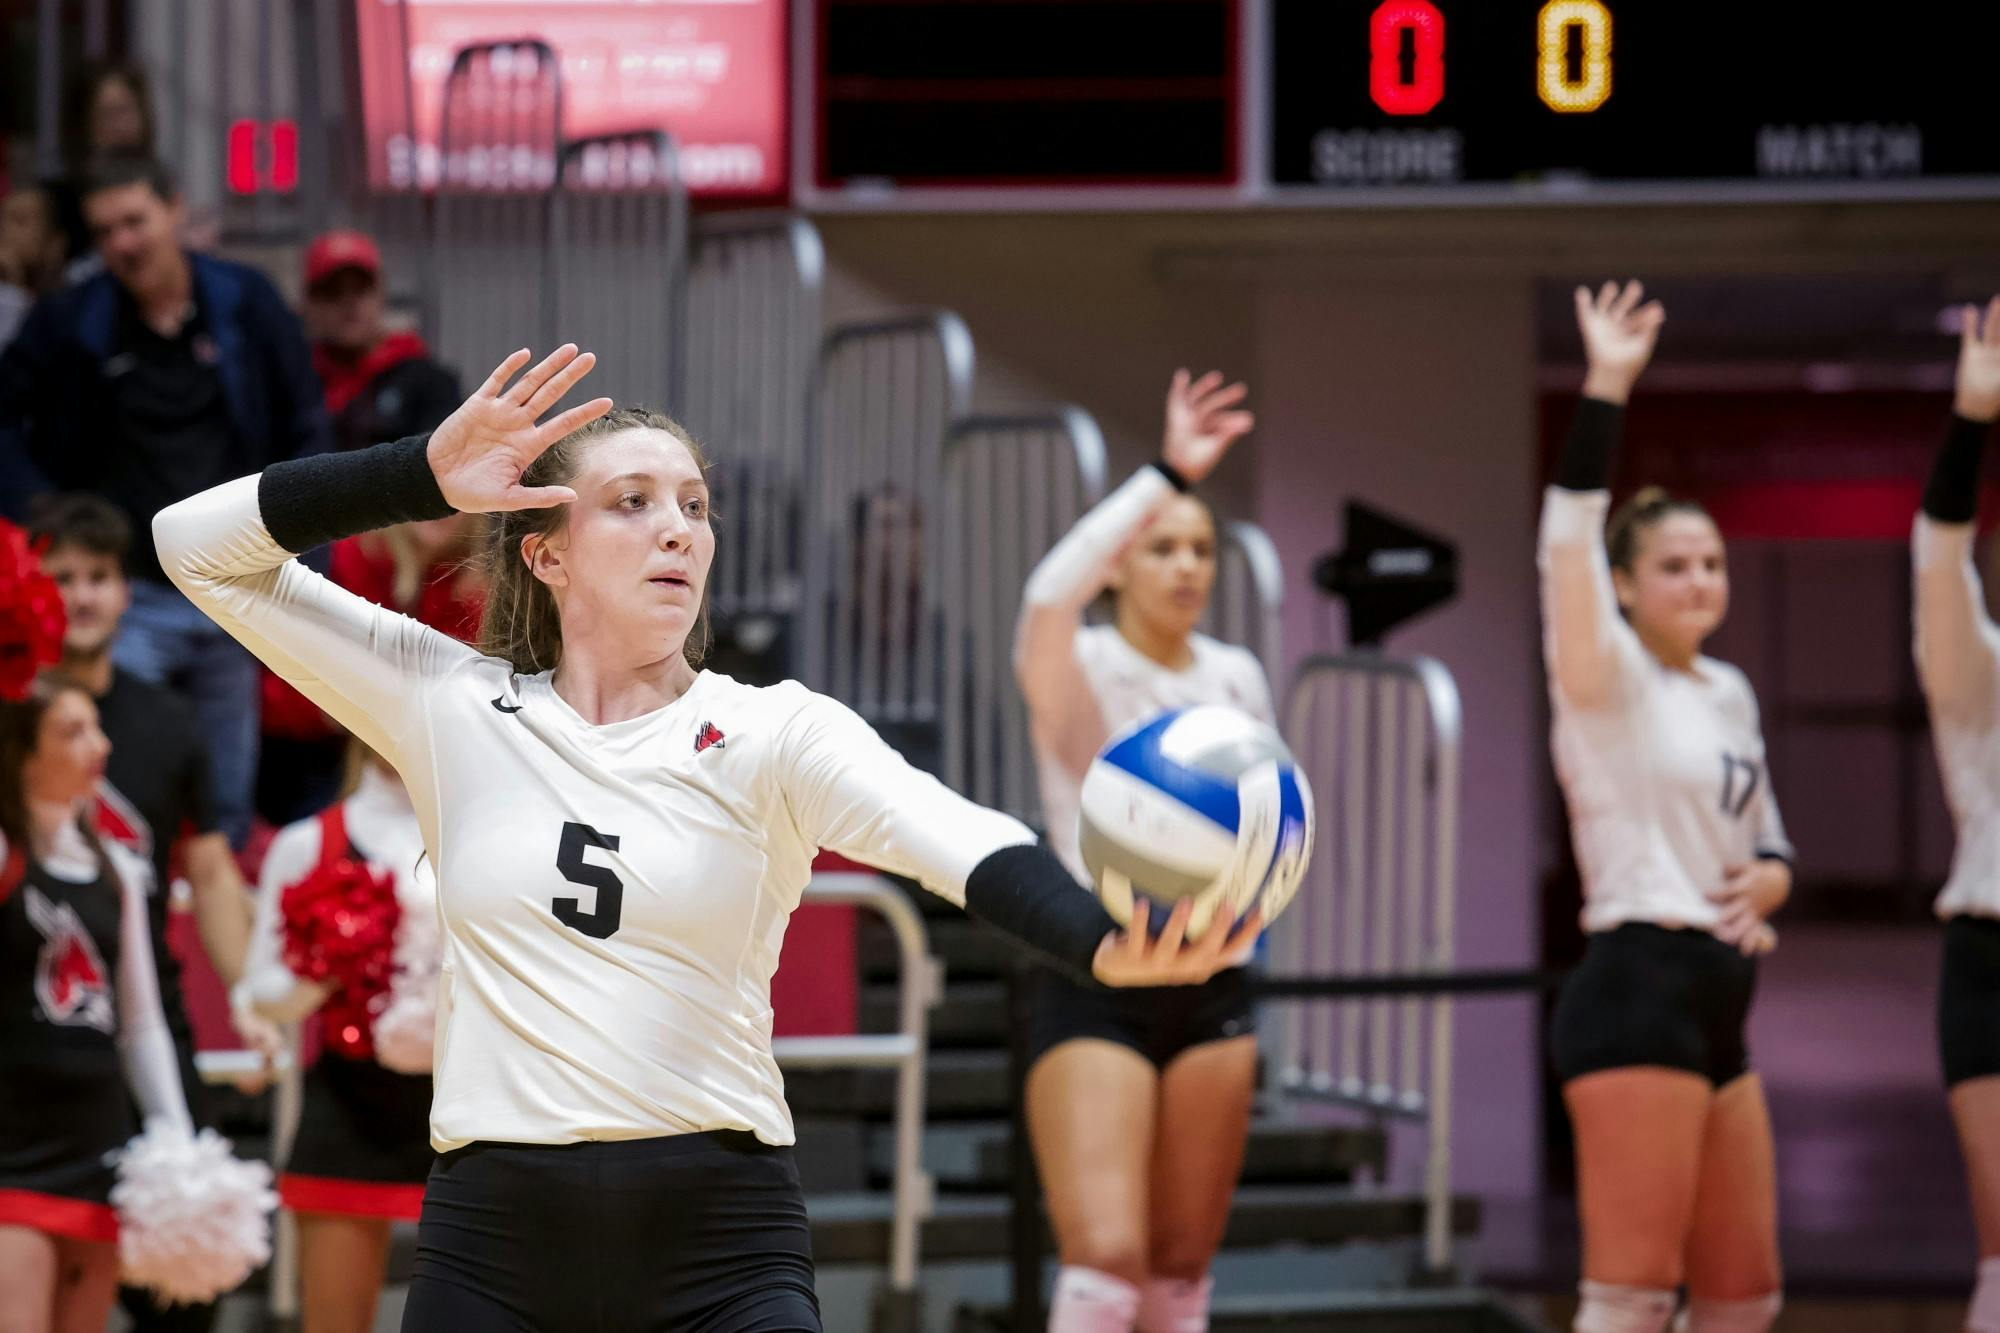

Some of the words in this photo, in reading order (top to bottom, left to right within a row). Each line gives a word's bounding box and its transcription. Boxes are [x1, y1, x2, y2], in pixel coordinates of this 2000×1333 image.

[1369, 0, 1446, 115] 0
[1536, 0, 1613, 113] 0
[1312, 130, 1461, 180] SCORE
[1757, 124, 1921, 174] MATCH
[1720, 751, 1761, 819] 17
[551, 821, 624, 940] 5
